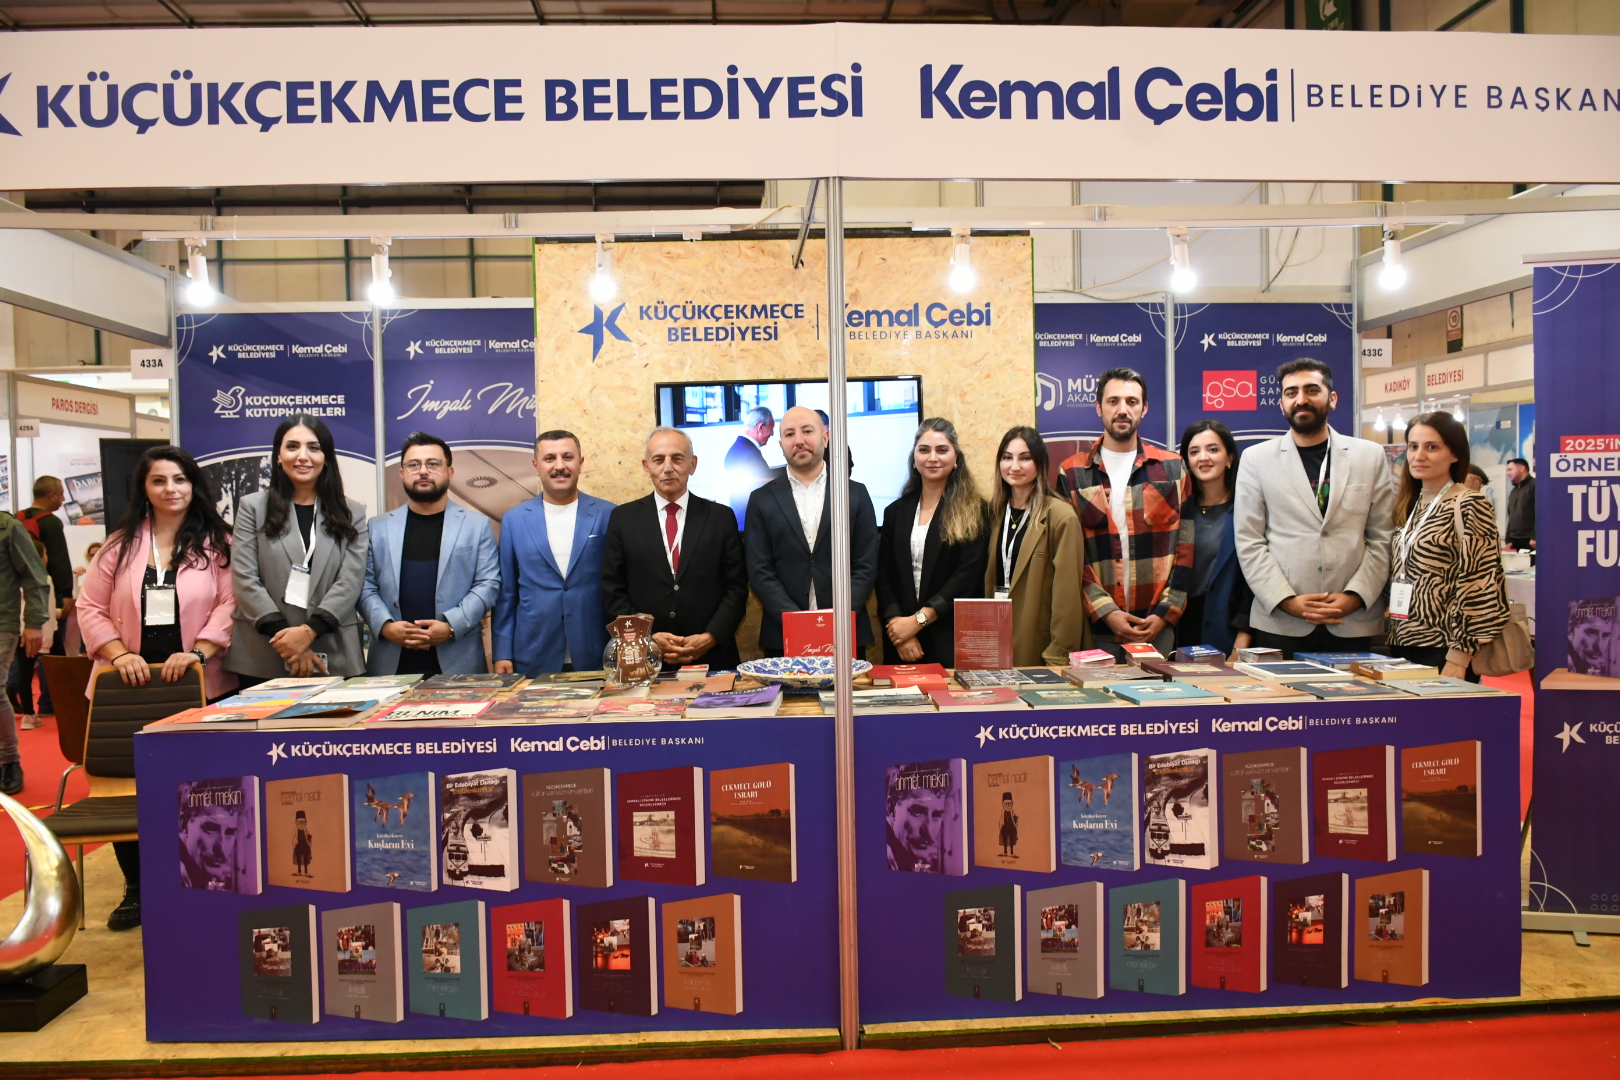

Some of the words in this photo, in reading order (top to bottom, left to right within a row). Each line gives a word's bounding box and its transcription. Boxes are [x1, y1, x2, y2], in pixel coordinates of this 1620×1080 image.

[36, 70, 526, 135] KÜÇÜKÇEKMECE
[544, 62, 864, 121] BELEDİYESİ
[920, 64, 1121, 120] Kemal
[1134, 66, 1279, 126] Çebi
[1487, 86, 1620, 113] BAŞKAN
[638, 302, 805, 323] KÜÇÜKÇEKMECE
[844, 302, 920, 328] emal
[924, 301, 991, 329] Çebi
[667, 321, 779, 343] BELEDİYESİ
[915, 330, 974, 341] BAŞKANI
[1089, 333, 1119, 343] Kemal
[1120, 333, 1142, 343] Çebi
[1218, 332, 1270, 340] KÜÇÜKÇEKMECE
[1276, 333, 1305, 343] Kemal
[1305, 333, 1327, 344] Çebi
[228, 343, 285, 352] KÜÇÜKÇEKMECE
[291, 343, 323, 354] Kemal
[324, 343, 348, 355] Çebi
[425, 339, 482, 348] KÜÇÜKÇEKMECE
[488, 339, 520, 349] Kemal
[1038, 339, 1075, 347] BELEDİYESİ
[1226, 339, 1262, 347] BELEDİYESİ
[237, 351, 276, 359] BELEDİYESİ
[434, 346, 473, 354] BELEDİYESİ
[1362, 348, 1383, 357] 433C
[140, 359, 164, 368] 433A
[1260, 374, 1280, 384] GÜ
[1384, 376, 1411, 394] KADIKÖY
[1427, 365, 1464, 387] BELEDİYESİ
[245, 394, 345, 407] KÜÇÜKÇEKMECE
[396, 379, 472, 420] İmzalı
[1066, 393, 1097, 403] AKAD
[51, 397, 74, 413] PAROS
[1555, 454, 1620, 473] ÖRNE
[1577, 530, 1620, 568] FU
[998, 725, 1117, 741] KÜÇÜKÇEKMECE
[1120, 719, 1199, 736] BELEDİYESİ
[1211, 716, 1262, 733] Kemal
[1264, 714, 1302, 732] Çebi
[1355, 715, 1397, 726] BAŞKANI
[290, 741, 412, 758] KÜÇÜKÇEKMECE
[415, 738, 497, 755] BELEDİYESİ
[510, 737, 563, 753] Kemal
[566, 735, 606, 753] Çebi
[660, 736, 705, 747] BAŞKANI
[1072, 820, 1103, 831] Kuşların
[1104, 819, 1118, 830] Evi
[367, 839, 400, 851] Kuşların
[401, 838, 415, 850] Evi
